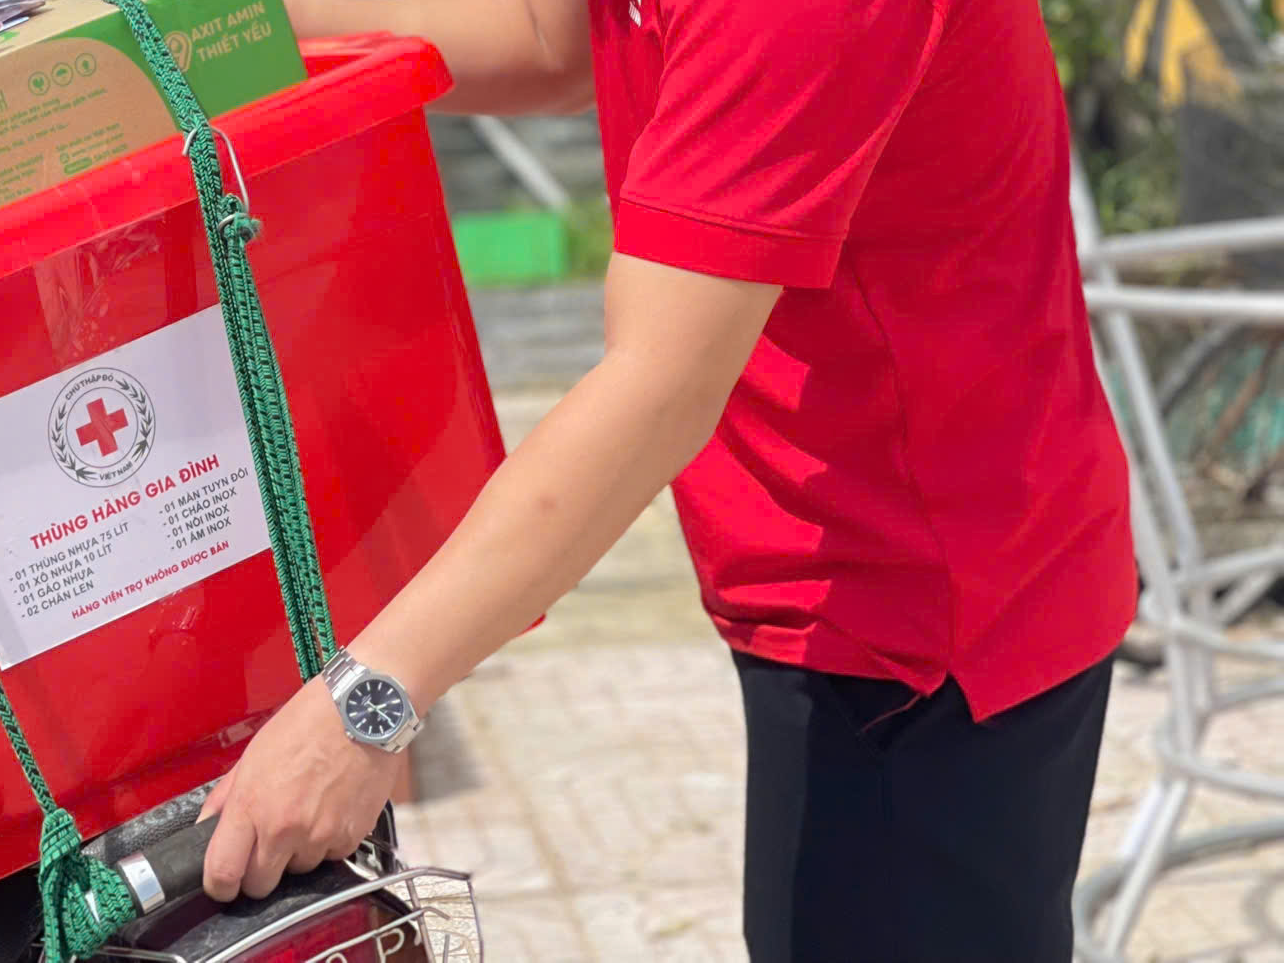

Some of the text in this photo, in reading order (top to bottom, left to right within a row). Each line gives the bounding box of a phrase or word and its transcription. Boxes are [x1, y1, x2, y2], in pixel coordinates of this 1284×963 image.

[191, 0, 265, 42] AXIT AMIN
[117, 461, 134, 475] NAM
[202, 476, 229, 495] TUYN
[230, 467, 249, 482] ĐÔI
[30, 454, 220, 550] THÙNG HÀNG GIA ĐÌNH
[212, 487, 237, 505] INOX
[205, 503, 230, 522] INOX
[207, 516, 232, 535] INOX
[29, 551, 66, 574] THÙNG
[67, 536, 99, 558] NHỰA
[100, 531, 113, 542] 75
[113, 522, 129, 537] LÍT
[50, 558, 82, 578] NHỰA
[83, 552, 95, 564] 10
[98, 543, 113, 558] LÍT
[63, 567, 94, 587] NHỰA
[71, 600, 100, 619] HÀNG
[144, 564, 179, 586] KHÔNG
[181, 550, 208, 569] ĐƯỢC
[210, 540, 230, 555] BÁN
[73, 580, 94, 597] LEN
